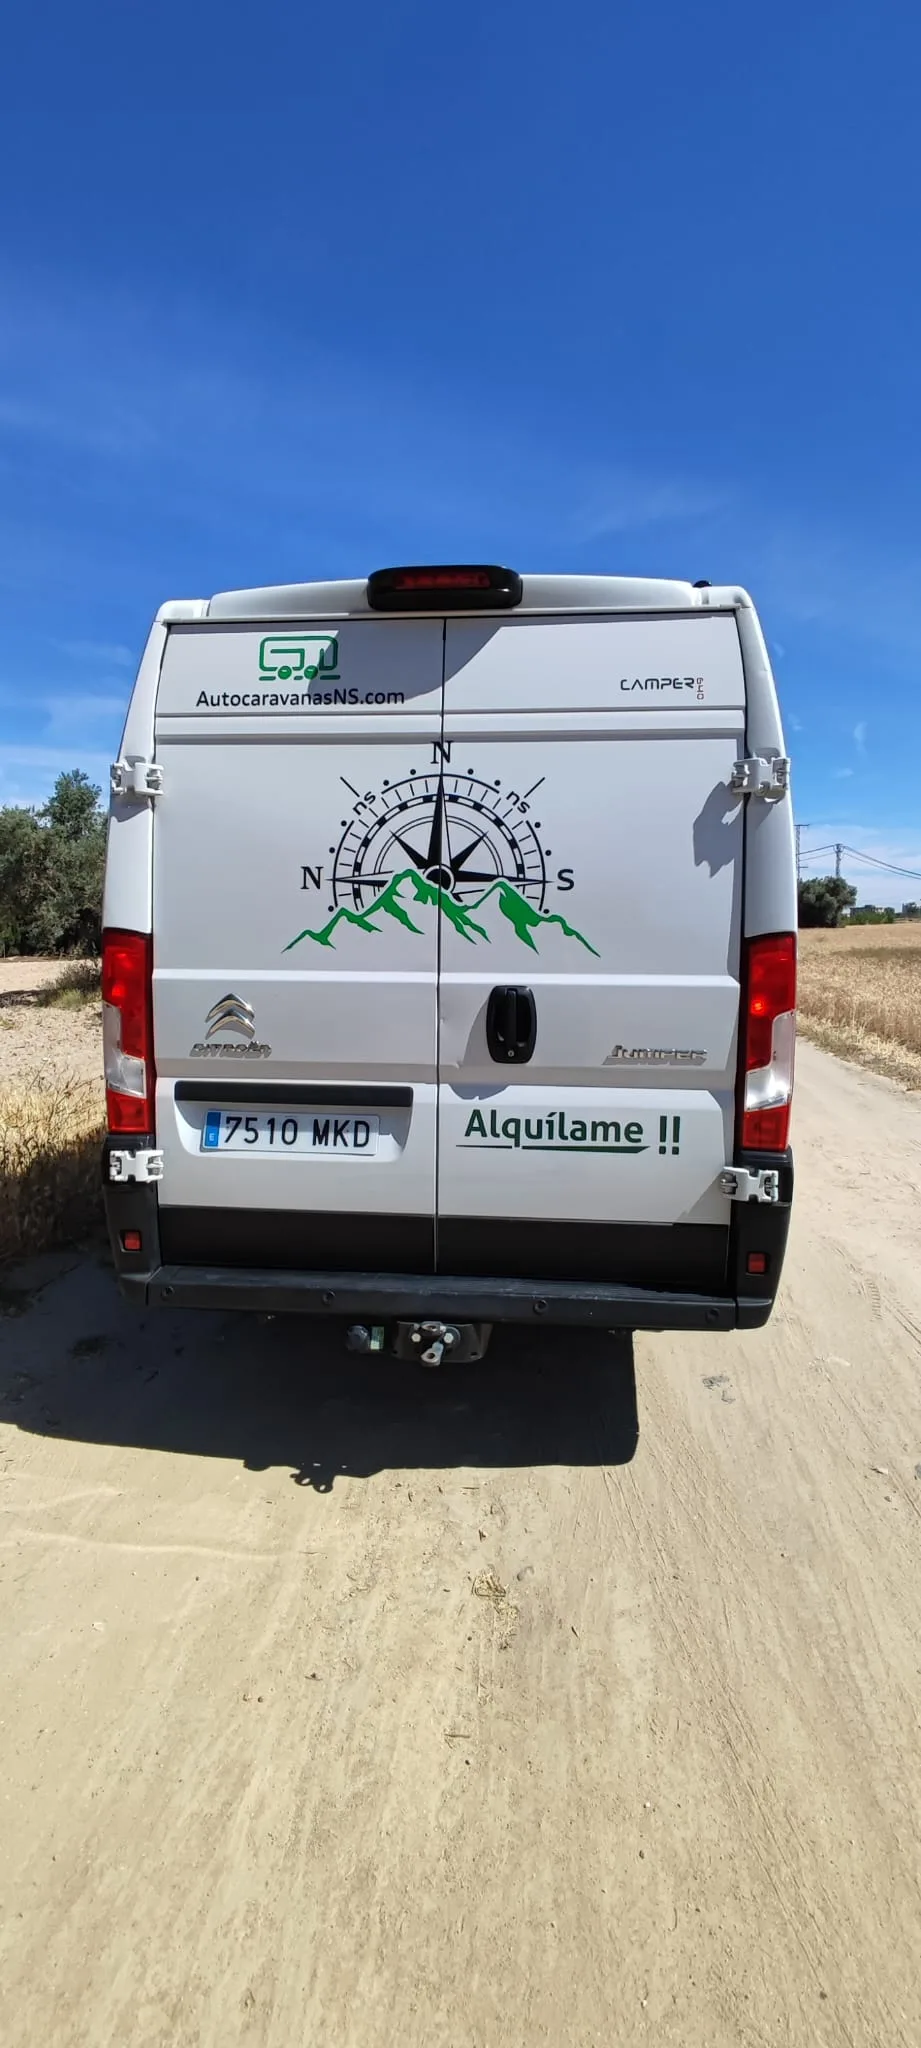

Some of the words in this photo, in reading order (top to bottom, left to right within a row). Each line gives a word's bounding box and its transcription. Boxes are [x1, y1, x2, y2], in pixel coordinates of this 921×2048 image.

[620, 677, 694, 690] CAMPER
[196, 688, 405, 707] AutocaravanasNS.com
[430, 740, 454, 764] N
[352, 791, 376, 815] ns
[506, 790, 530, 814] ns
[300, 866, 324, 890] N
[557, 868, 574, 891] S
[208, 1133, 215, 1142] E
[224, 1116, 298, 1145] 7510
[312, 1119, 370, 1148] MKD
[464, 1109, 643, 1148] Alquílame
[658, 1115, 681, 1155] !!
